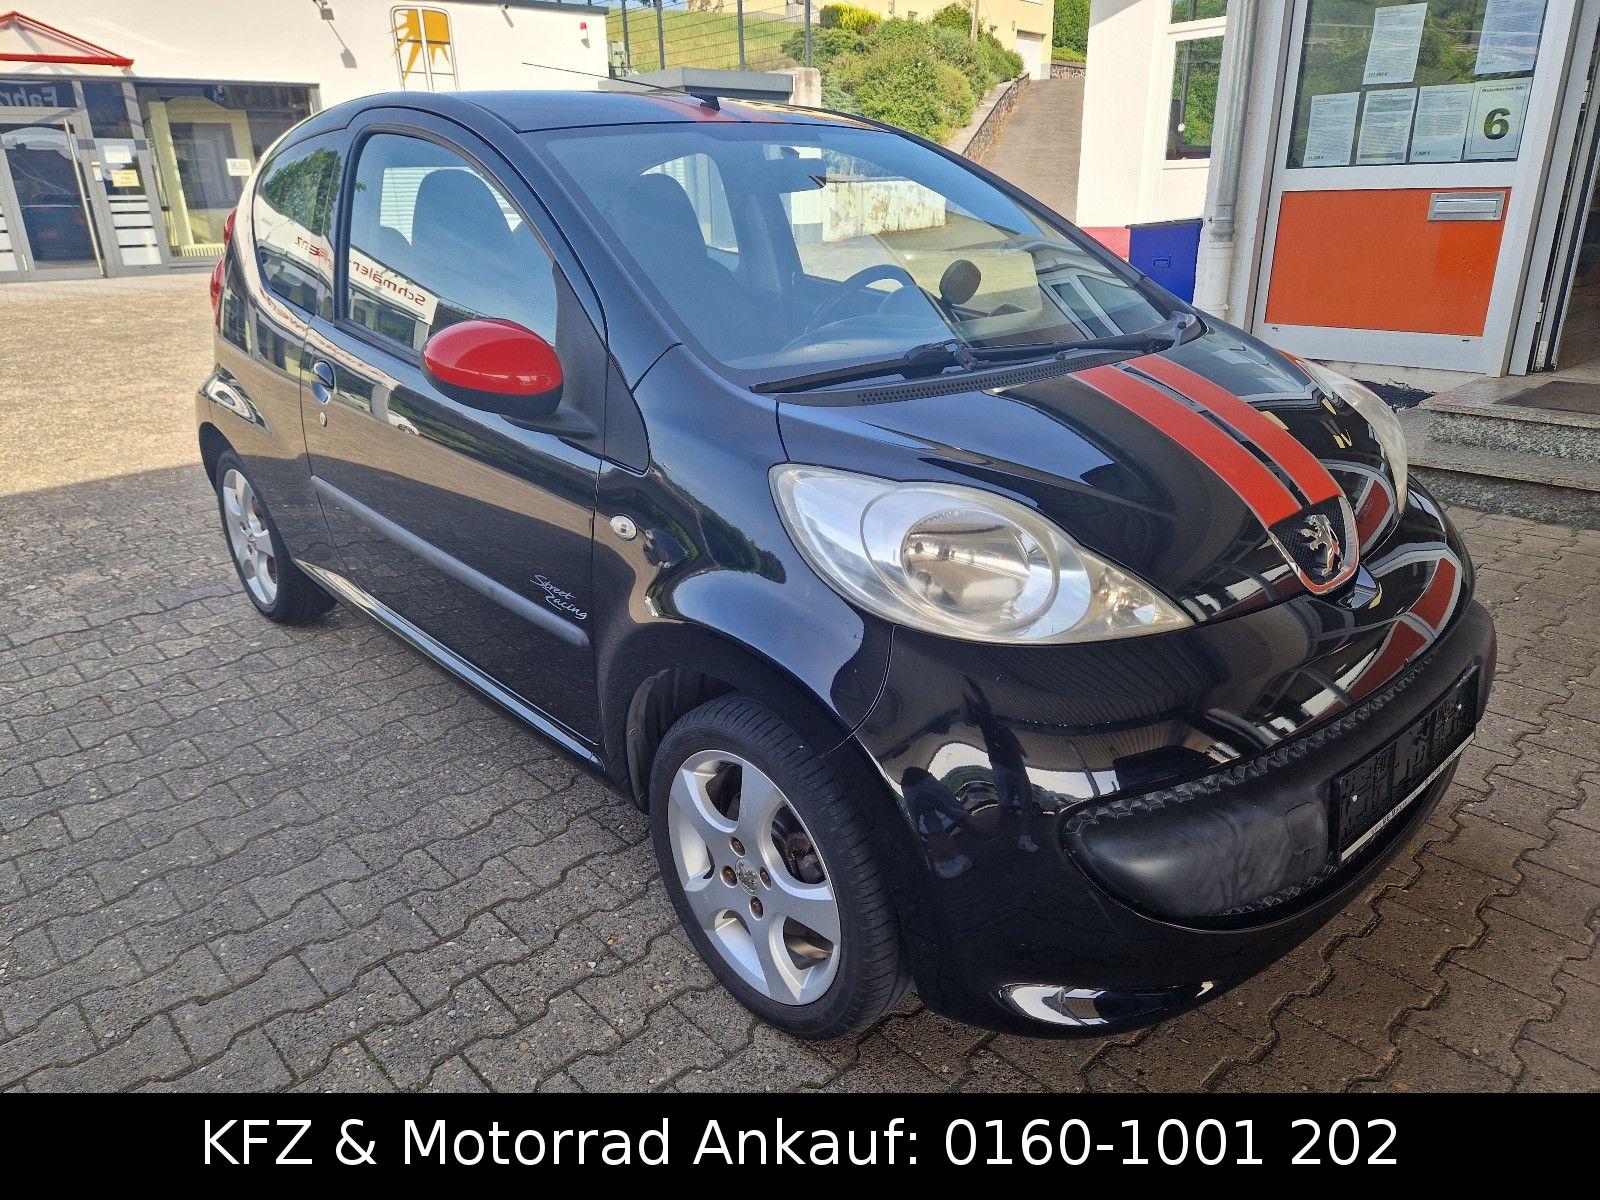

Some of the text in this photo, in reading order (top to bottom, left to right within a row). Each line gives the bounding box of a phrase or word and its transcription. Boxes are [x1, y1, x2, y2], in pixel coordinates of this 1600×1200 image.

[1484, 108, 1510, 140] 6
[529, 574, 576, 600] Street
[542, 586, 588, 620] Racing
